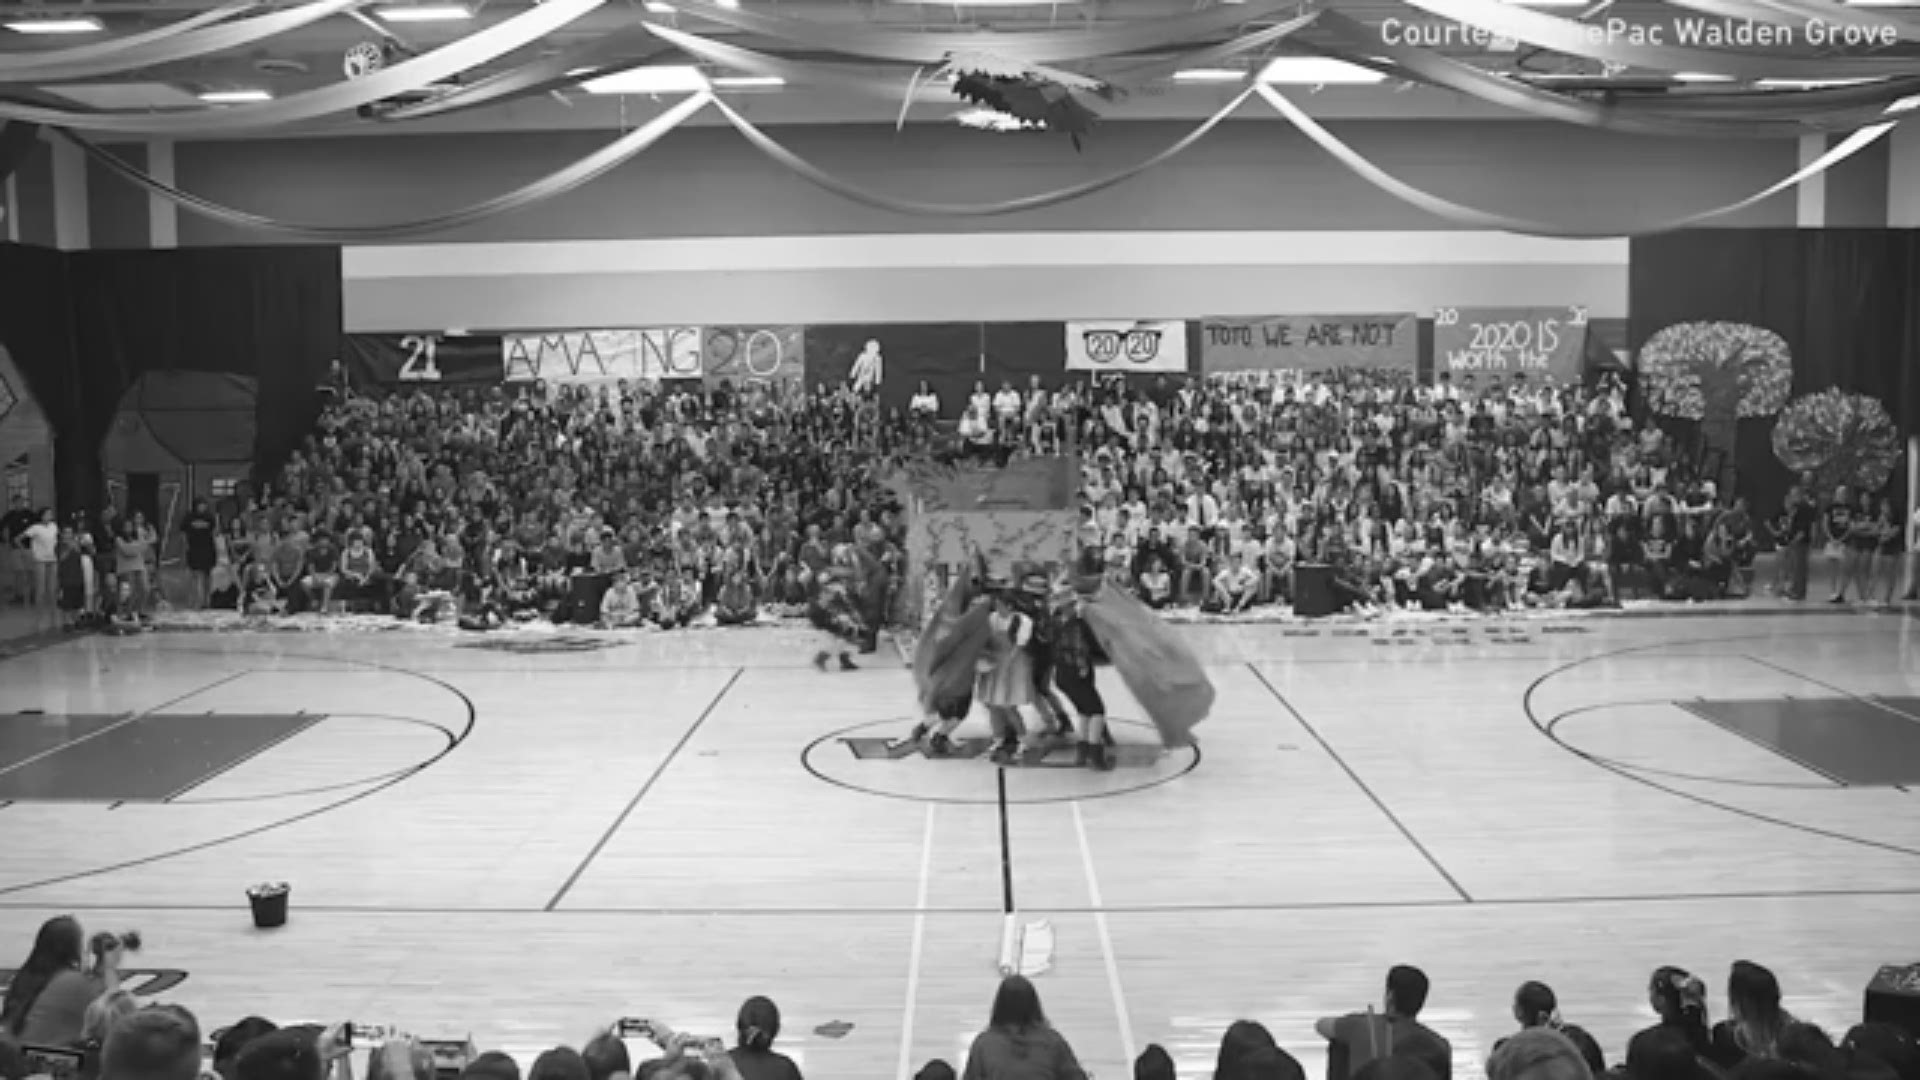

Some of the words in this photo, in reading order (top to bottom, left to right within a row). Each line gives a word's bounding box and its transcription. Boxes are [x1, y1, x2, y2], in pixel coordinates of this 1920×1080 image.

[1092, 334, 1116, 354] 20
[1130, 332, 1156, 354] 20
[1205, 325, 1251, 347] TOTO
[1262, 324, 1292, 346] WE
[1305, 324, 1342, 346] ARE
[1351, 323, 1396, 346] NOT
[1469, 321, 1531, 350] 2020
[1538, 318, 1559, 351] IS
[399, 335, 442, 380] 21
